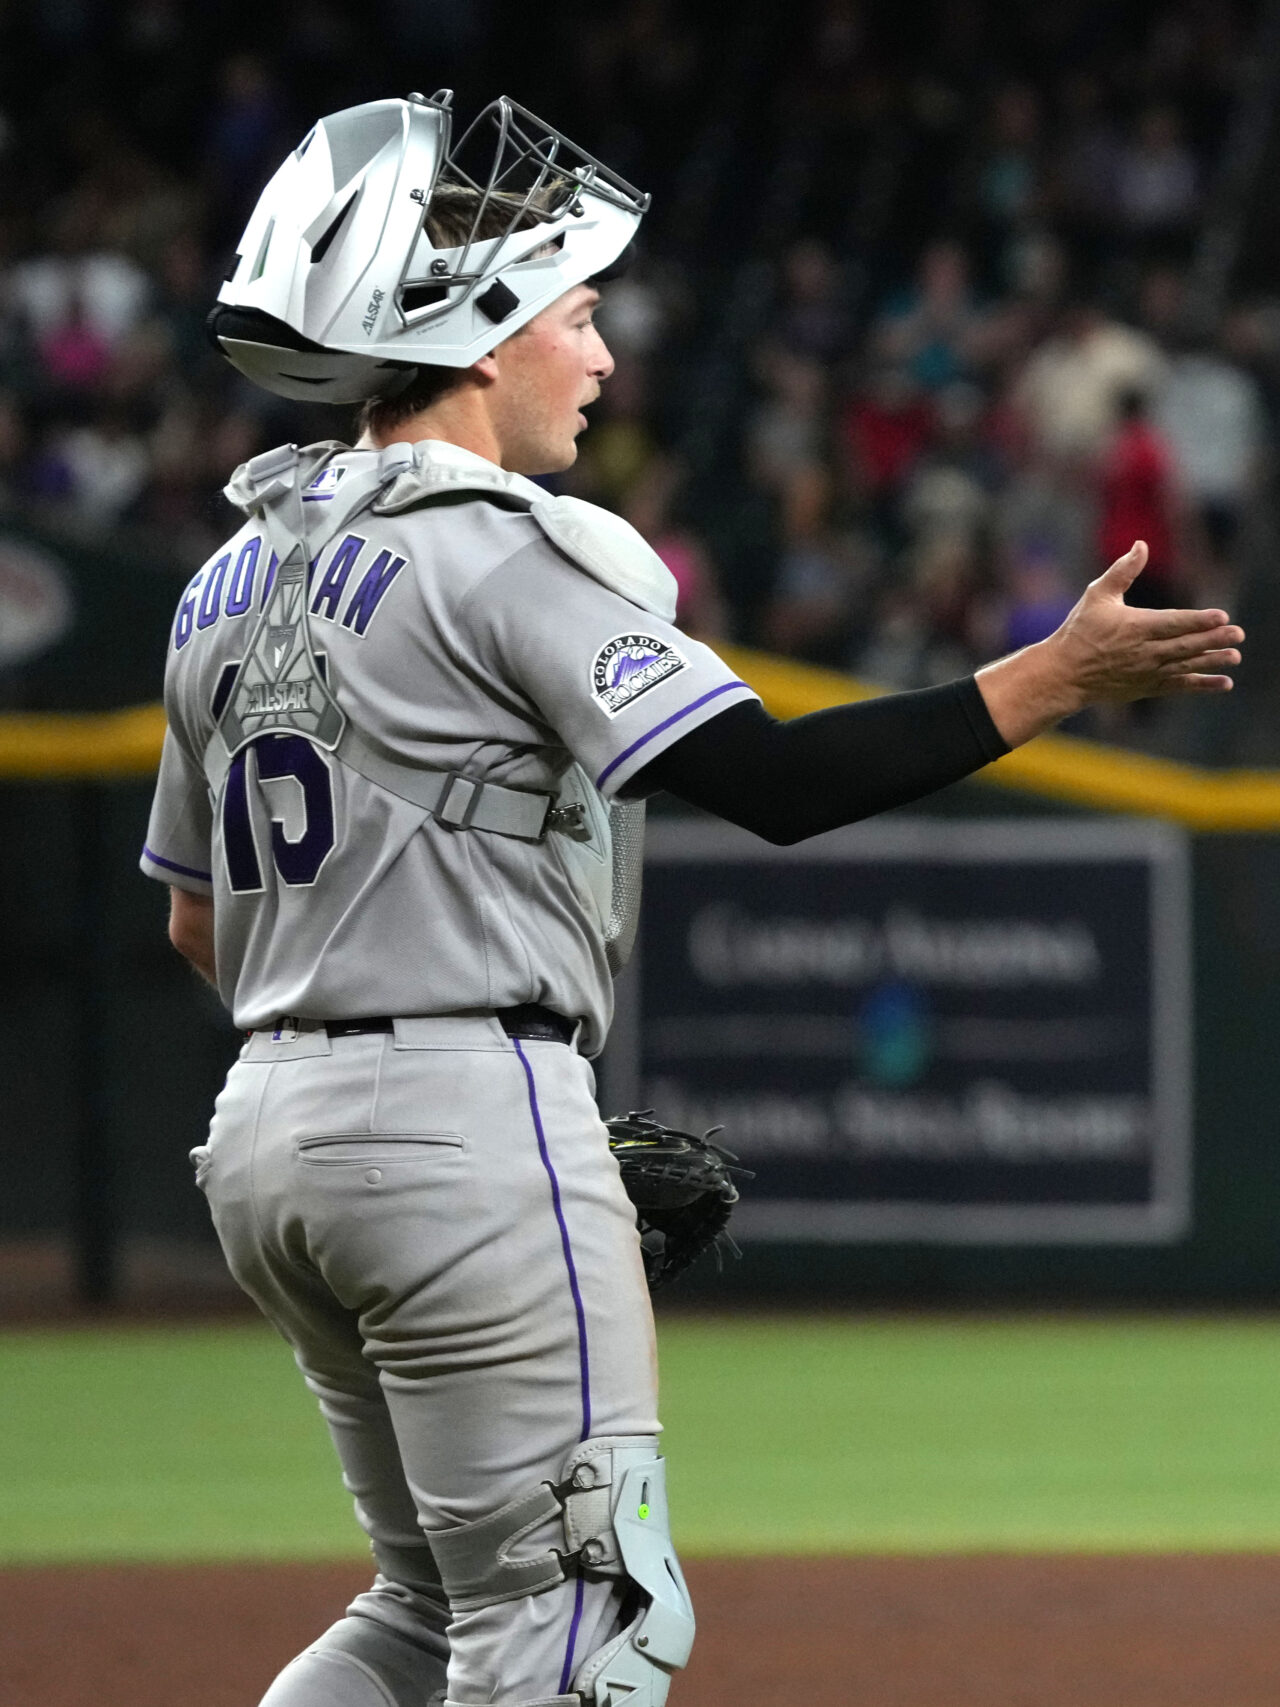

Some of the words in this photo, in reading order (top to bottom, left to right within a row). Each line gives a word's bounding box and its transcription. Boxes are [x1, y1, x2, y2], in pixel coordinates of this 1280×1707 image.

[174, 532, 410, 654] GOOAN
[595, 636, 662, 687] COLORADO
[600, 650, 682, 710] ROCKIES
